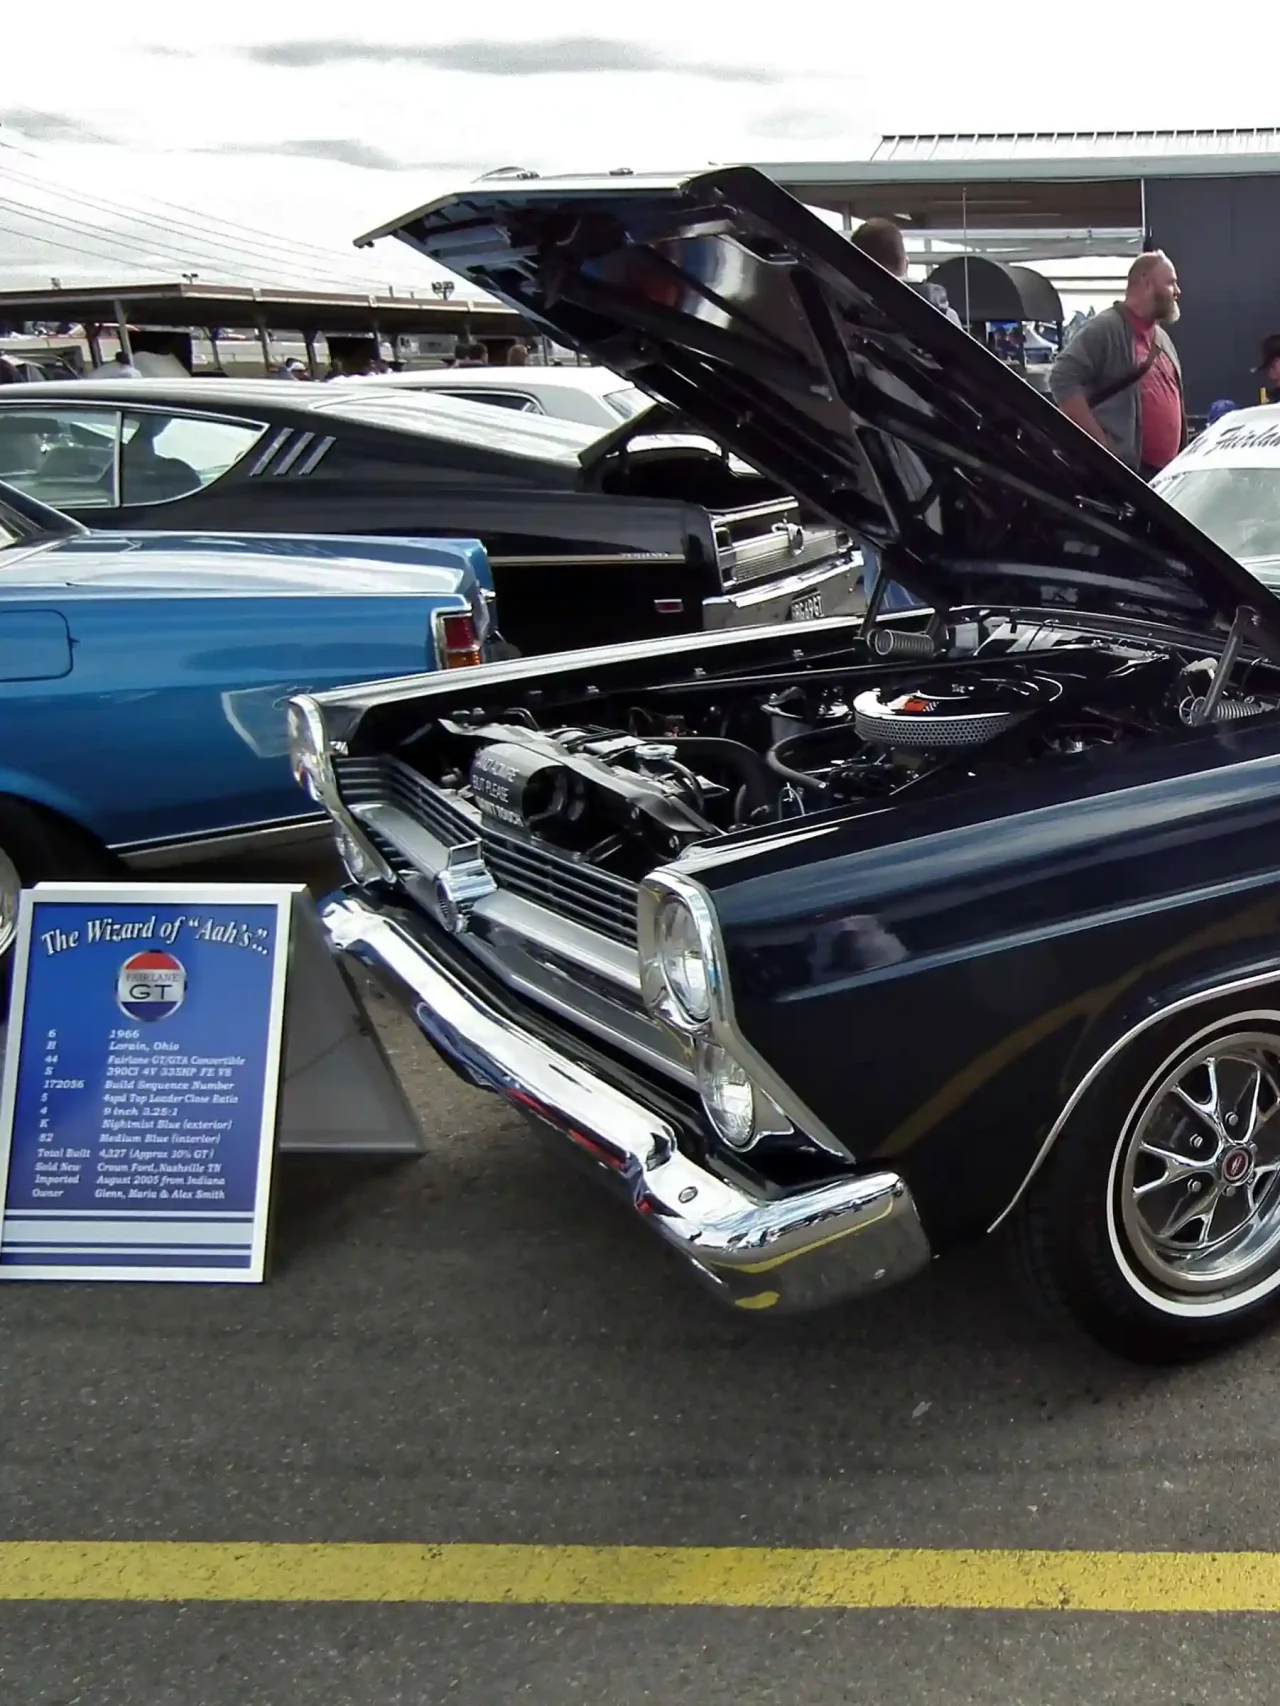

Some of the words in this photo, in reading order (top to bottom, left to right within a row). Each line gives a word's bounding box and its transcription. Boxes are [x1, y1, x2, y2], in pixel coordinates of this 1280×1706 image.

[41, 928, 79, 956] The
[87, 916, 156, 944] Wizard
[160, 916, 185, 945] of
[126, 972, 179, 983] FAIRLANE
[129, 984, 172, 1000] GT
[47, 1028, 57, 1038] 6
[108, 1028, 140, 1039] 1966
[153, 1041, 180, 1051] Ohio
[44, 1054, 59, 1064] 44
[107, 1055, 150, 1065] Fairlane
[190, 1055, 246, 1066] Convertible
[104, 1080, 135, 1089] Build
[136, 1080, 190, 1091] Sequence
[191, 1080, 236, 1090] Number
[129, 1093, 148, 1104] Top
[149, 1094, 185, 1103] Loader
[184, 1095, 210, 1103] Close
[212, 1095, 239, 1103] Ratio
[103, 1107, 112, 1116] 9
[113, 1107, 139, 1116] inch
[101, 1119, 155, 1131] Nightmist
[156, 1119, 182, 1129] Blue
[182, 1119, 233, 1130] (exterior)
[99, 1133, 142, 1143] Medium
[144, 1134, 170, 1143] Blue
[171, 1133, 221, 1144] (interior)
[37, 1148, 65, 1157] Total
[65, 1148, 91, 1157] Built
[34, 1161, 59, 1171] Sold
[60, 1162, 82, 1171] New
[97, 1162, 129, 1172] Crown
[159, 1163, 205, 1173] Nashville
[35, 1174, 80, 1186] Imported
[96, 1175, 131, 1187] August
[133, 1175, 160, 1185] 2005
[159, 1175, 185, 1187] from
[187, 1176, 225, 1185] Indiana
[32, 1188, 65, 1198] Owner
[128, 1189, 158, 1199] Maria
[159, 1189, 169, 1199] &
[171, 1189, 194, 1199] Alex
[195, 1189, 226, 1199] Smith
